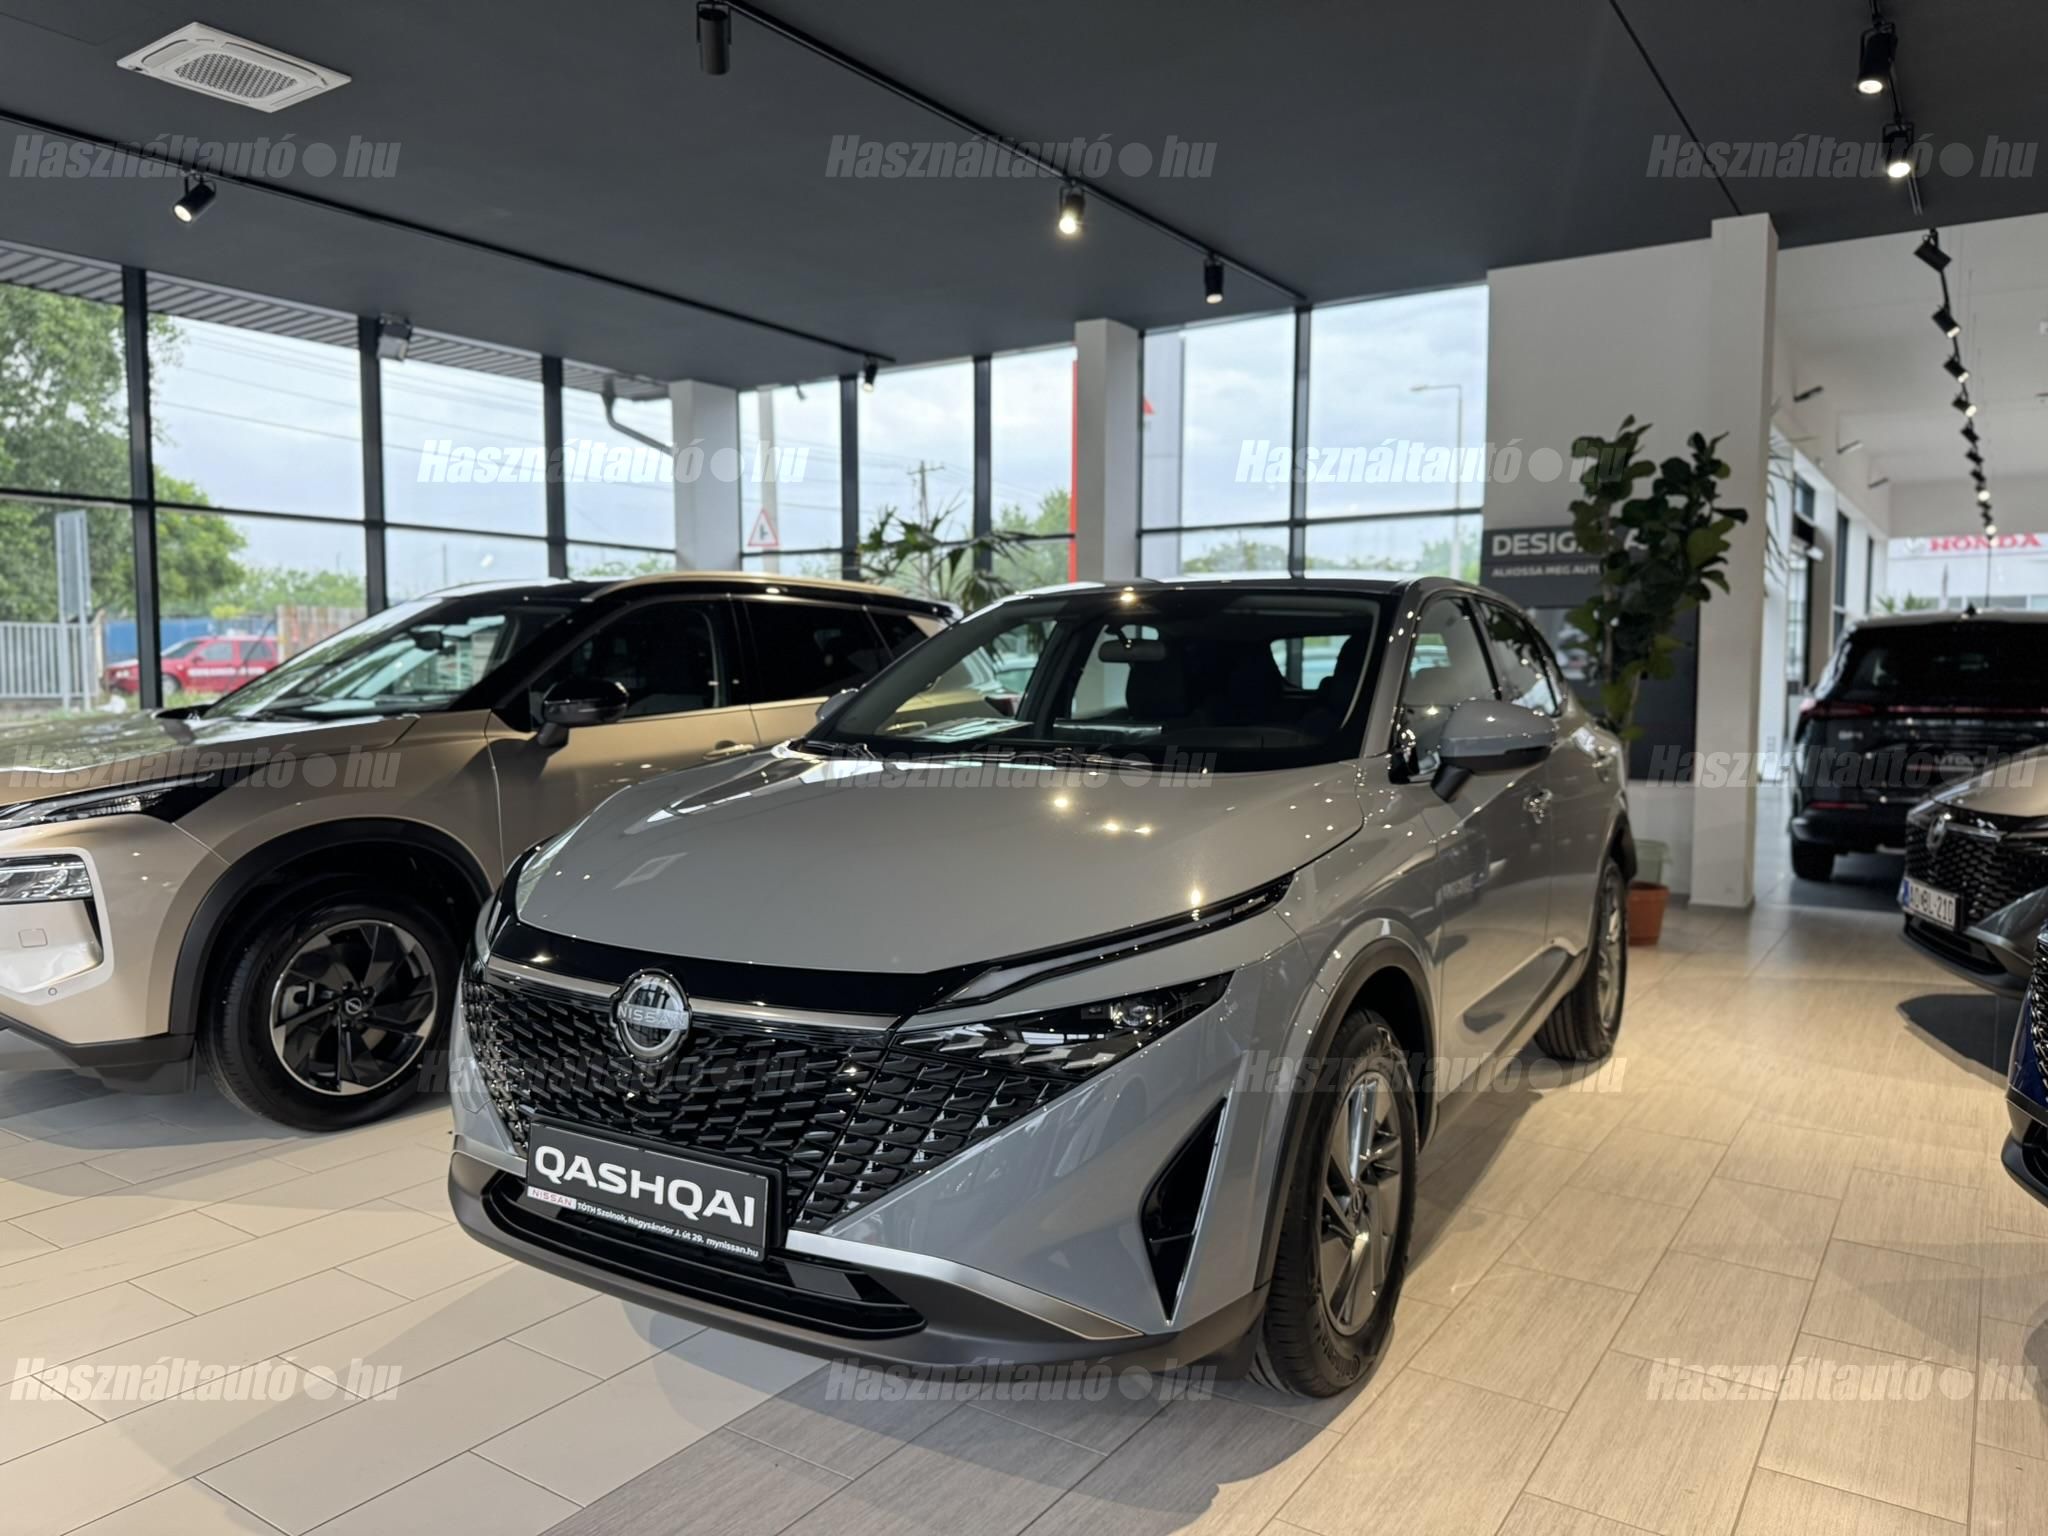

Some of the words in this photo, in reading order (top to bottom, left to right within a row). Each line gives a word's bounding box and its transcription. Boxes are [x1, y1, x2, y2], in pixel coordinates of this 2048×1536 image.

[1491, 530, 1585, 556] DESIG
[1929, 532, 2042, 552] HONDA
[617, 1004, 687, 1028] NISSAN
[532, 1188, 573, 1206] NISSAN
[534, 1145, 755, 1228] QASHQAI
[706, 1238, 759, 1258] mynissan.hu
